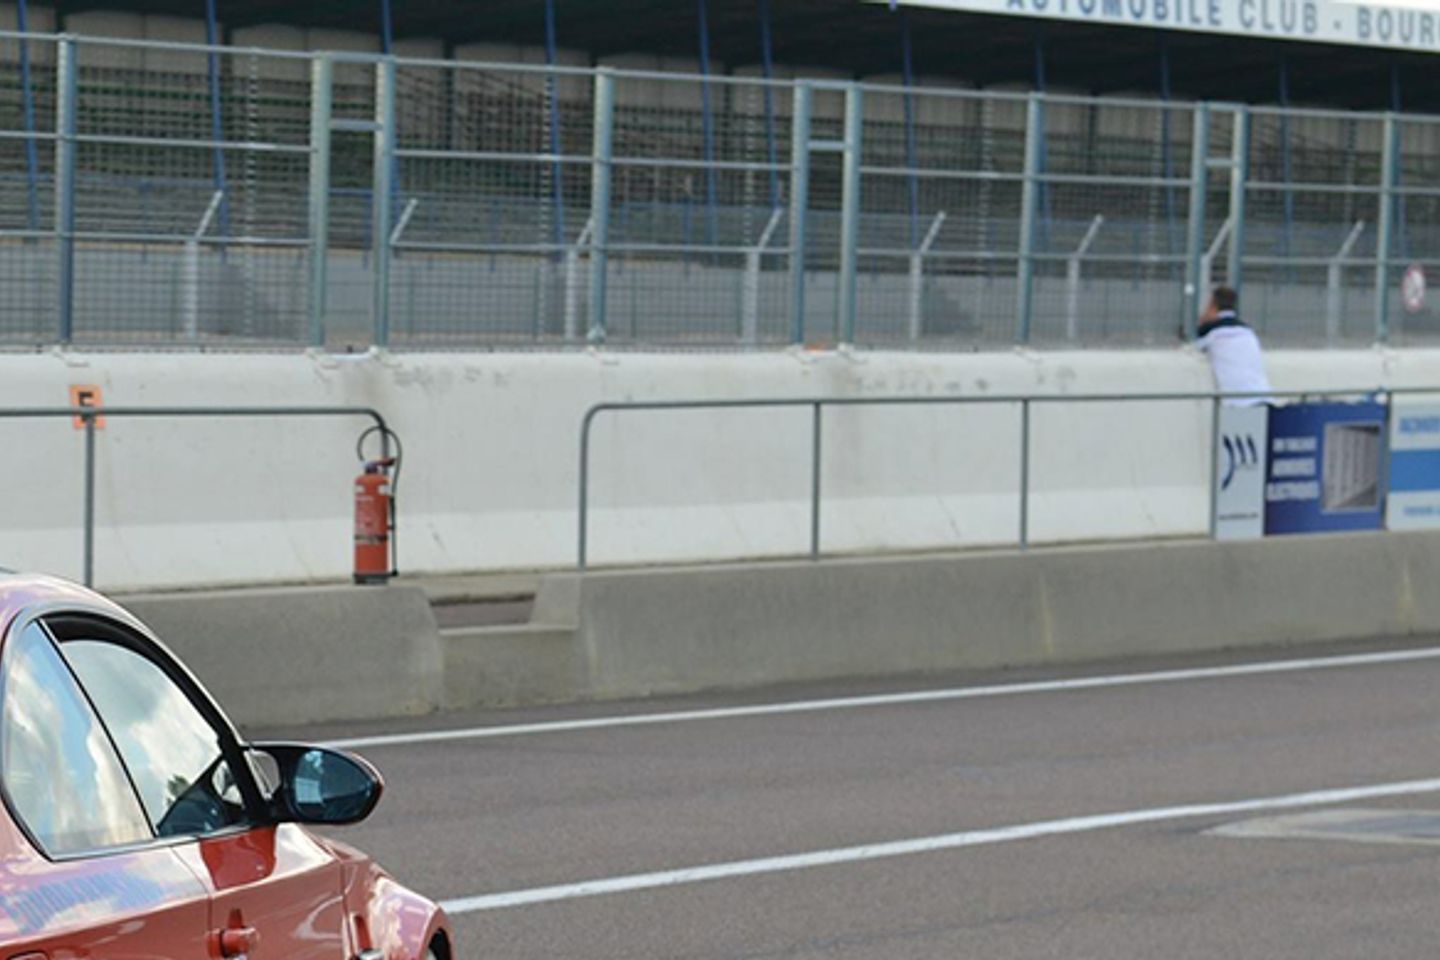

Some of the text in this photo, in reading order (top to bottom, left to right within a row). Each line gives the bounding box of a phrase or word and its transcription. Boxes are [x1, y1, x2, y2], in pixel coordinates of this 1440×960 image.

[1008, 0, 1440, 45] MOBILE CLUB BOUR
